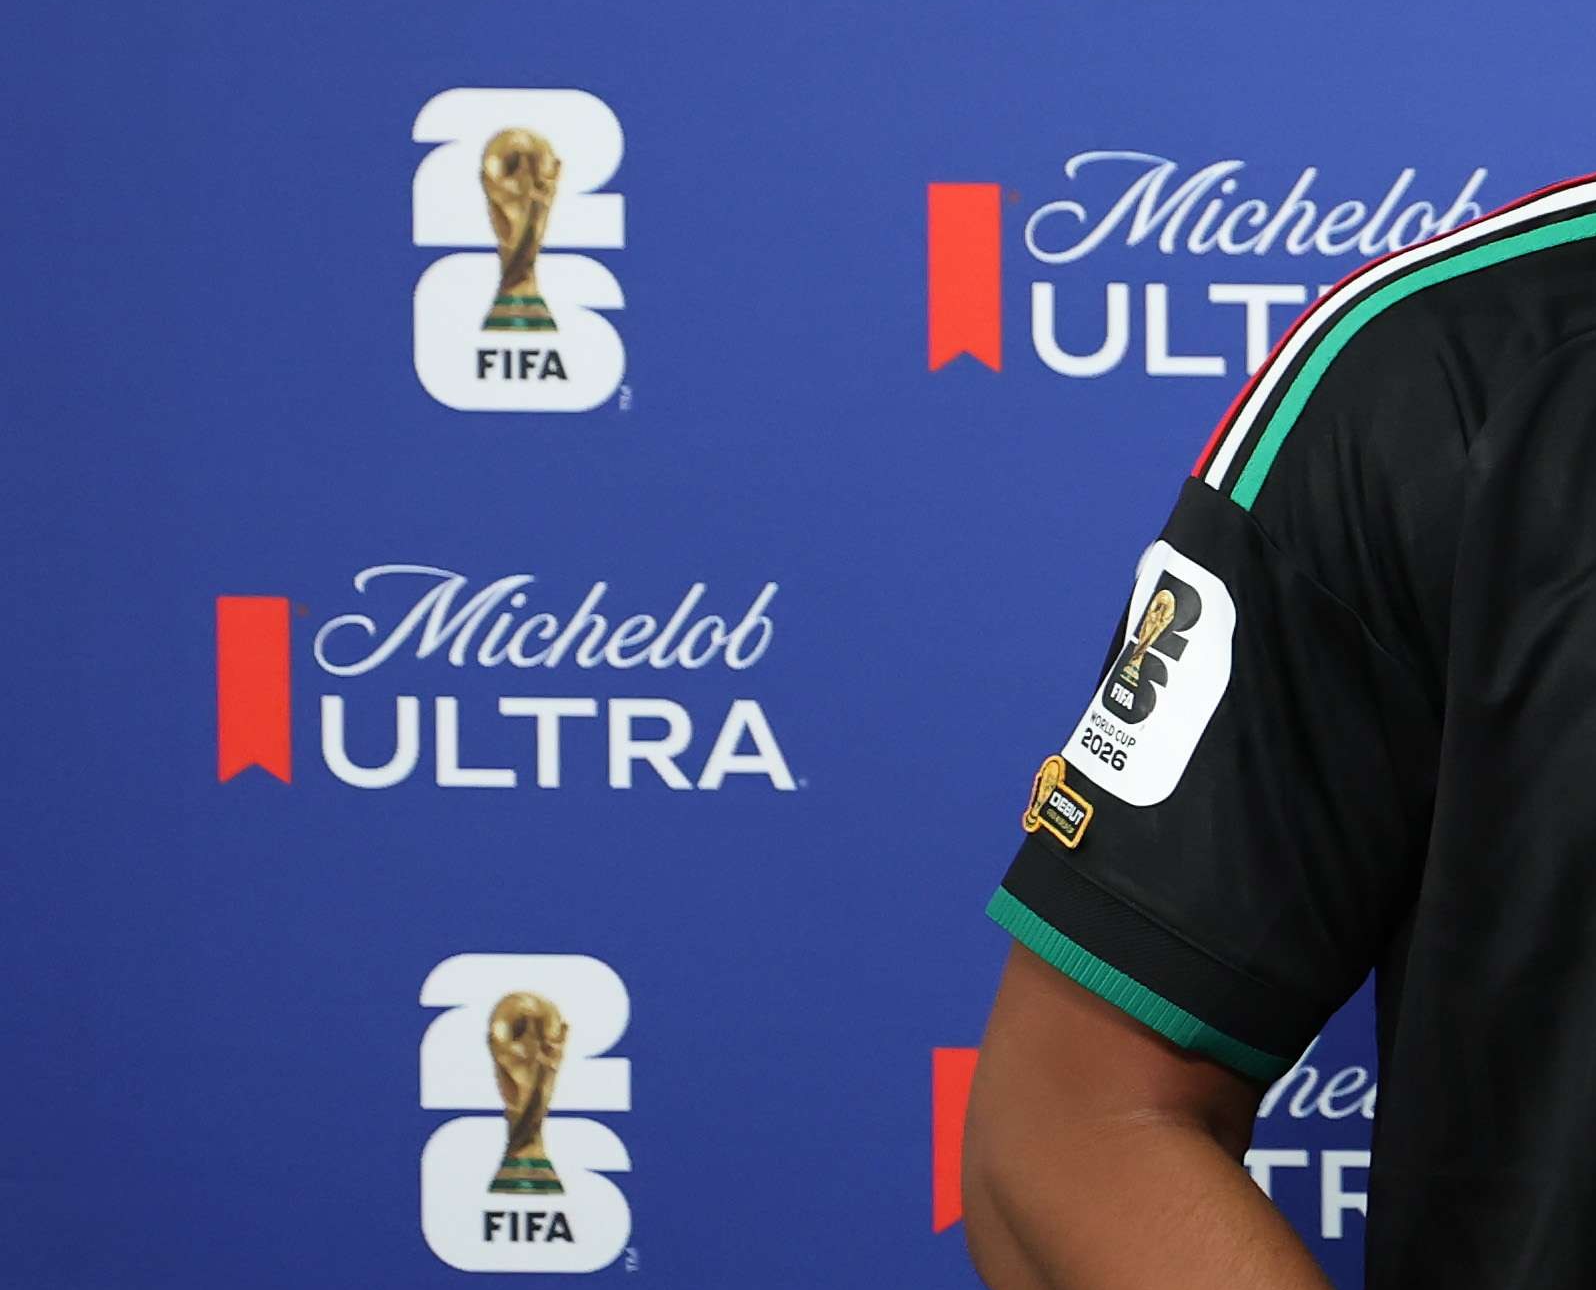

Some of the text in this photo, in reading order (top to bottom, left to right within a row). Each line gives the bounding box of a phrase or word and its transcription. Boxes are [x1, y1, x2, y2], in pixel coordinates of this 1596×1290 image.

[1032, 282, 1320, 376] ULT
[479, 351, 566, 379] FIFA
[314, 565, 778, 675] Michelob
[1110, 683, 1135, 710] FIFA
[321, 695, 796, 790] ULTRA
[1089, 710, 1136, 749] WORLD CUP
[1080, 727, 1128, 772] 2026
[1048, 791, 1085, 826] DEBUT
[485, 1212, 573, 1242] FIFA
